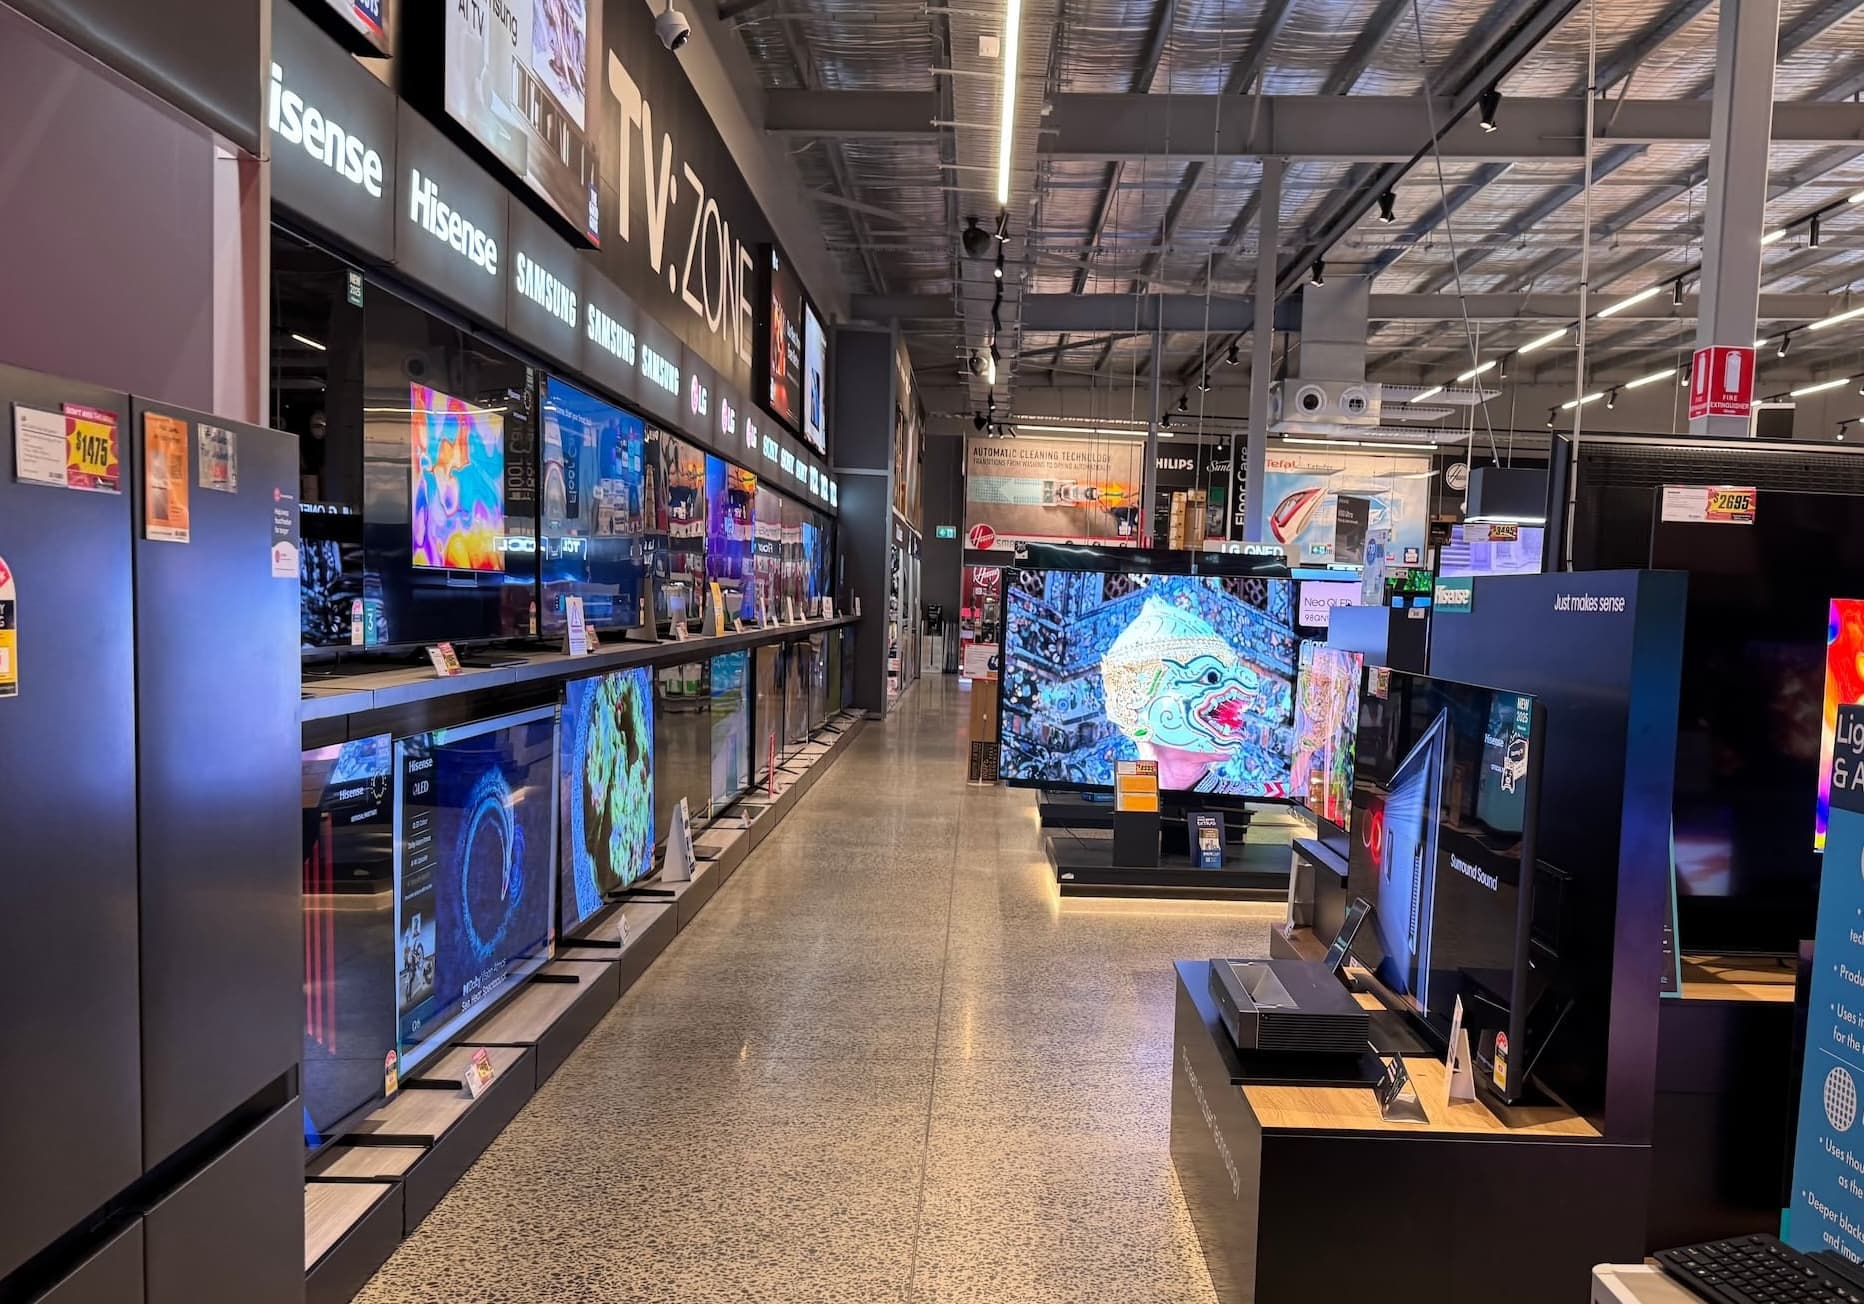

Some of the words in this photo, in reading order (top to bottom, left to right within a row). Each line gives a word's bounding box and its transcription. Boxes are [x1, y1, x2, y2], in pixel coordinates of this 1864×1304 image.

[470, 0, 485, 36] TV
[269, 61, 383, 198] isense
[410, 168, 498, 275] Hisense
[516, 251, 577, 329] SAMSUNG
[587, 303, 636, 367] SAMSUNG
[641, 344, 680, 397] SAMSUNG
[76, 430, 108, 466] $1475
[973, 447, 1016, 459] AUTOMATIC
[1020, 449, 1058, 461] CLEANING
[1155, 457, 1194, 470] HILIPS
[1237, 446, 1249, 483] Care
[1267, 459, 1297, 469] Tefal
[1235, 485, 1246, 525] Floor
[1304, 597, 1325, 607] Neo
[1554, 593, 1570, 611] Just
[1571, 593, 1598, 611] makes
[1599, 597, 1625, 612] sense
[409, 758, 433, 773] Hisense
[340, 787, 364, 800] Hisense
[1450, 853, 1476, 879] Surround
[1477, 866, 1498, 890] Sound
[1837, 1003, 1857, 1025] Uses
[1833, 1025, 1846, 1044] for
[1847, 1033, 1860, 1052] the
[1825, 1137, 1844, 1161] Uses
[1838, 1175, 1849, 1189] as
[1850, 1178, 1864, 1199] the
[1808, 1191, 1838, 1223] Deeper
[1823, 1231, 1840, 1250] and
